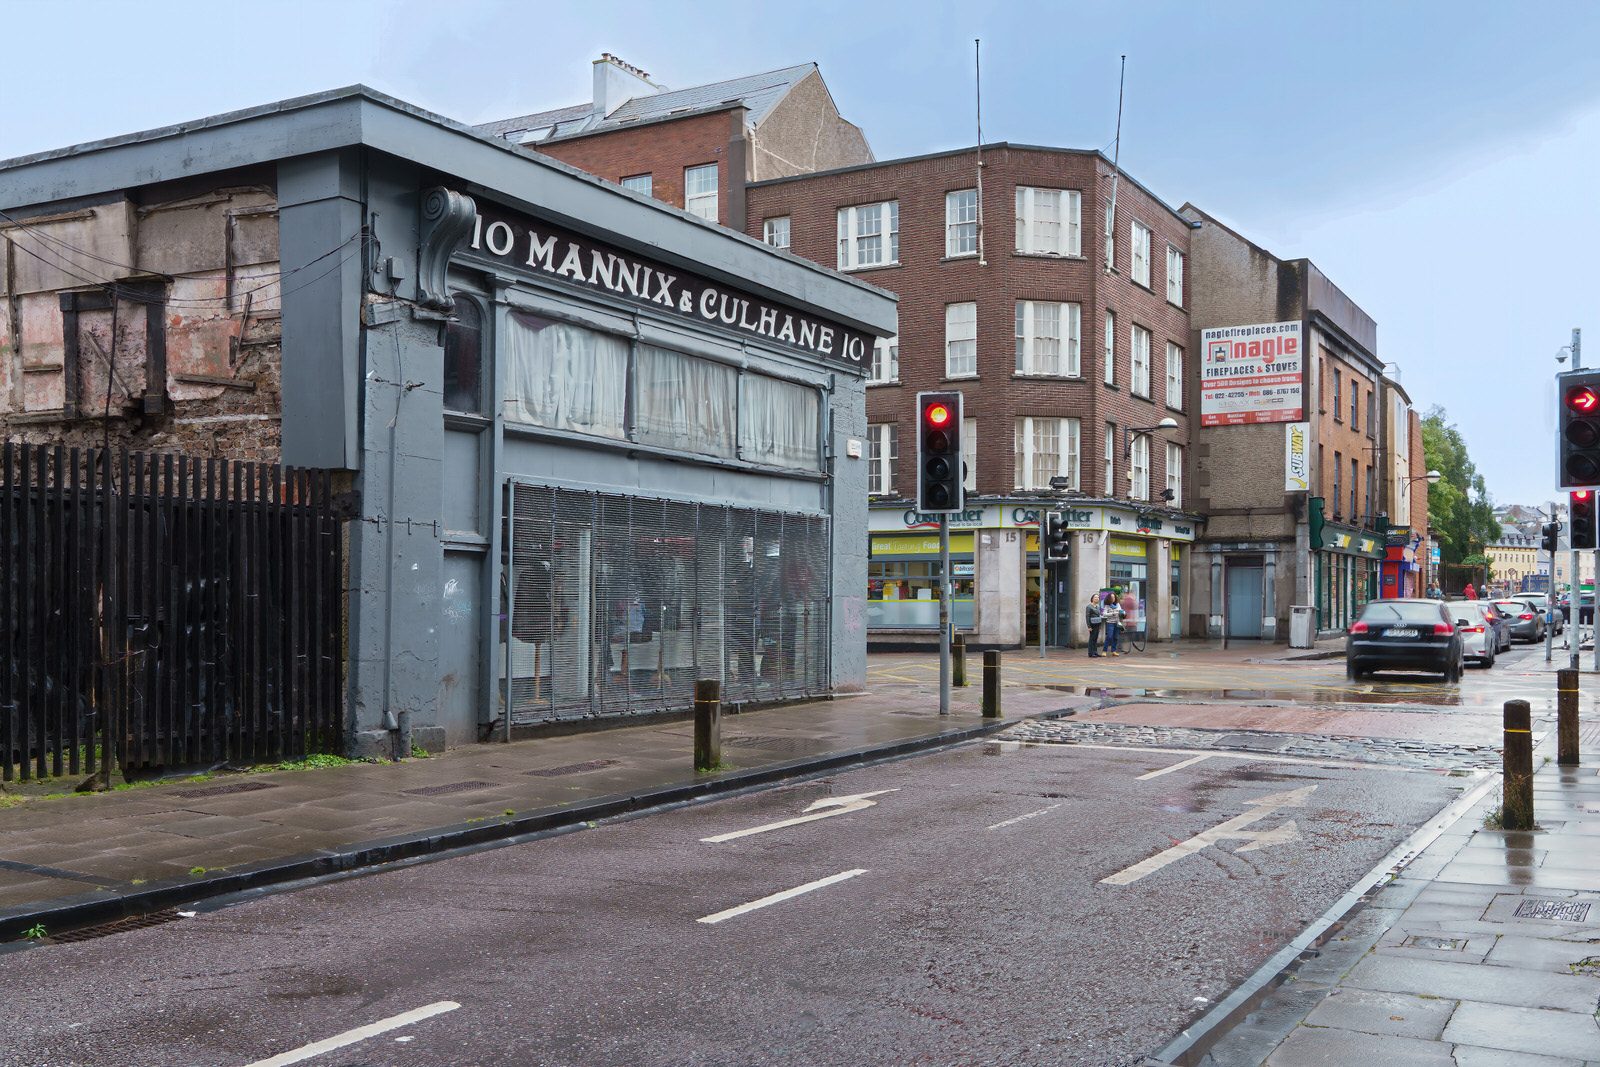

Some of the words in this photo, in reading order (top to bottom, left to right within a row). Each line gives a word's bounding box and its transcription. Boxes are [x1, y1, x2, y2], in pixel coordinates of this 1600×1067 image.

[471, 214, 514, 257] 10
[526, 230, 676, 308] MANNIX
[679, 289, 693, 313] &
[699, 287, 834, 355] CULHANE
[841, 332, 865, 362] 10
[1205, 324, 1298, 339] naglefireplaces.com
[1233, 335, 1297, 364] nagle
[1206, 365, 1255, 377] FIREPLACES
[1265, 362, 1298, 372] STOVES
[1229, 378, 1252, 386] Designs
[1259, 376, 1281, 384] choose
[1291, 425, 1304, 478] SUBWAY
[1005, 531, 1017, 543] 15
[1083, 532, 1094, 544] 16
